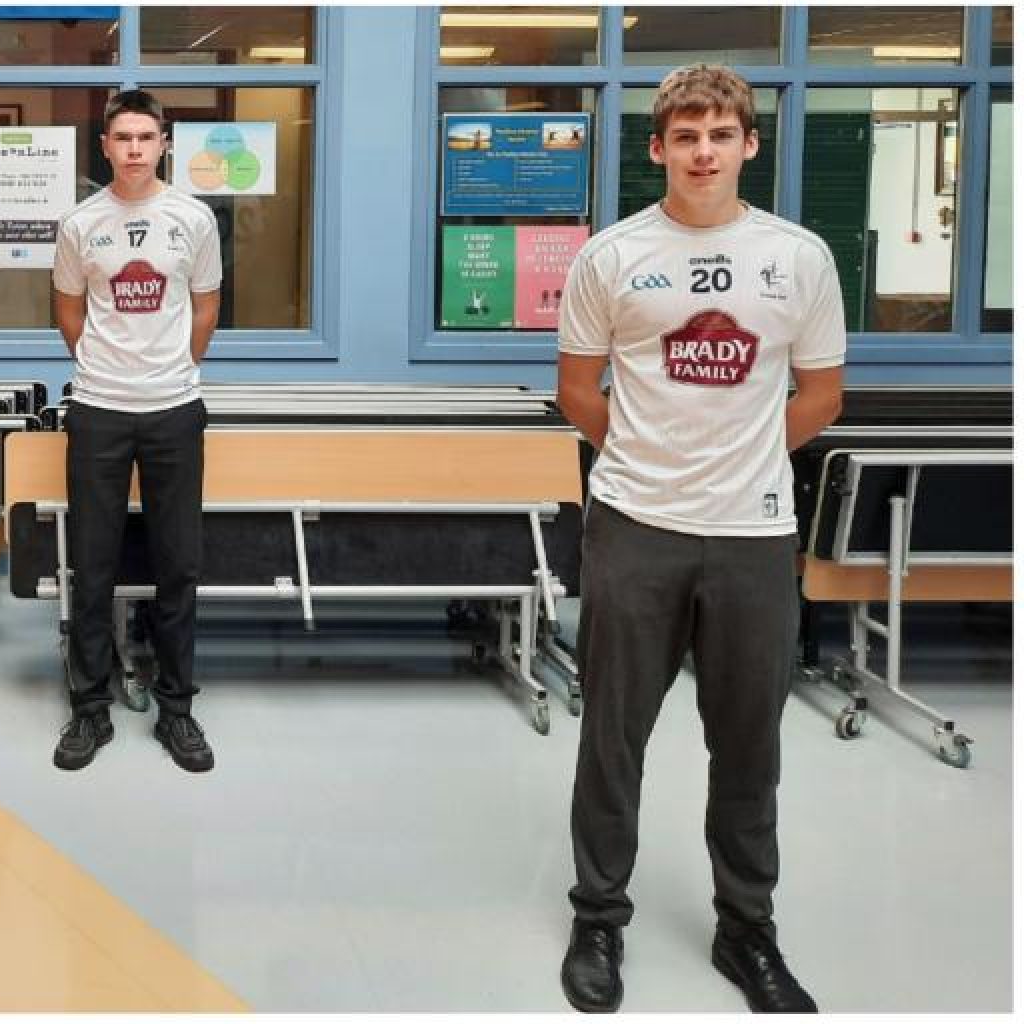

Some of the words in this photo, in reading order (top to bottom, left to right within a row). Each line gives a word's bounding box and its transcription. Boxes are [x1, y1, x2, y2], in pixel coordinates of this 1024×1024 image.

[127, 229, 148, 248] 17
[114, 280, 162, 297] BRADY
[689, 266, 734, 294] 20
[669, 339, 753, 364] BRADY
[673, 362, 740, 381] FAMILY
